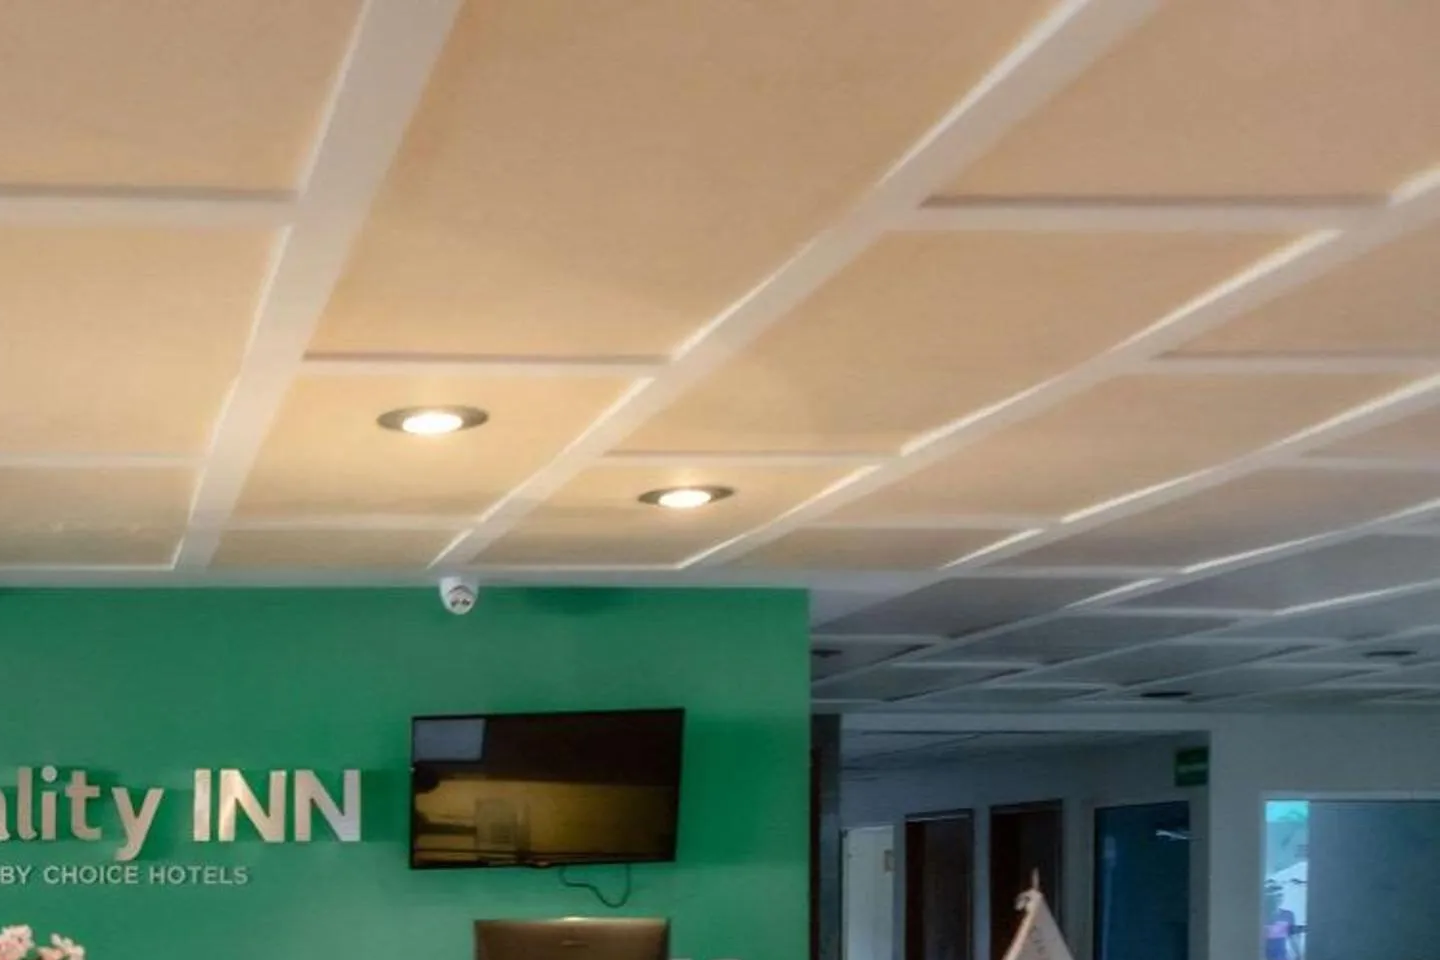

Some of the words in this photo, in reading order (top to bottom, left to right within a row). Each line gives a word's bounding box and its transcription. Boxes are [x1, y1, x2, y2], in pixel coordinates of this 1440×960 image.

[193, 768, 360, 843] INN
[43, 865, 139, 885] CHOICE
[149, 865, 249, 885] HOTELS
